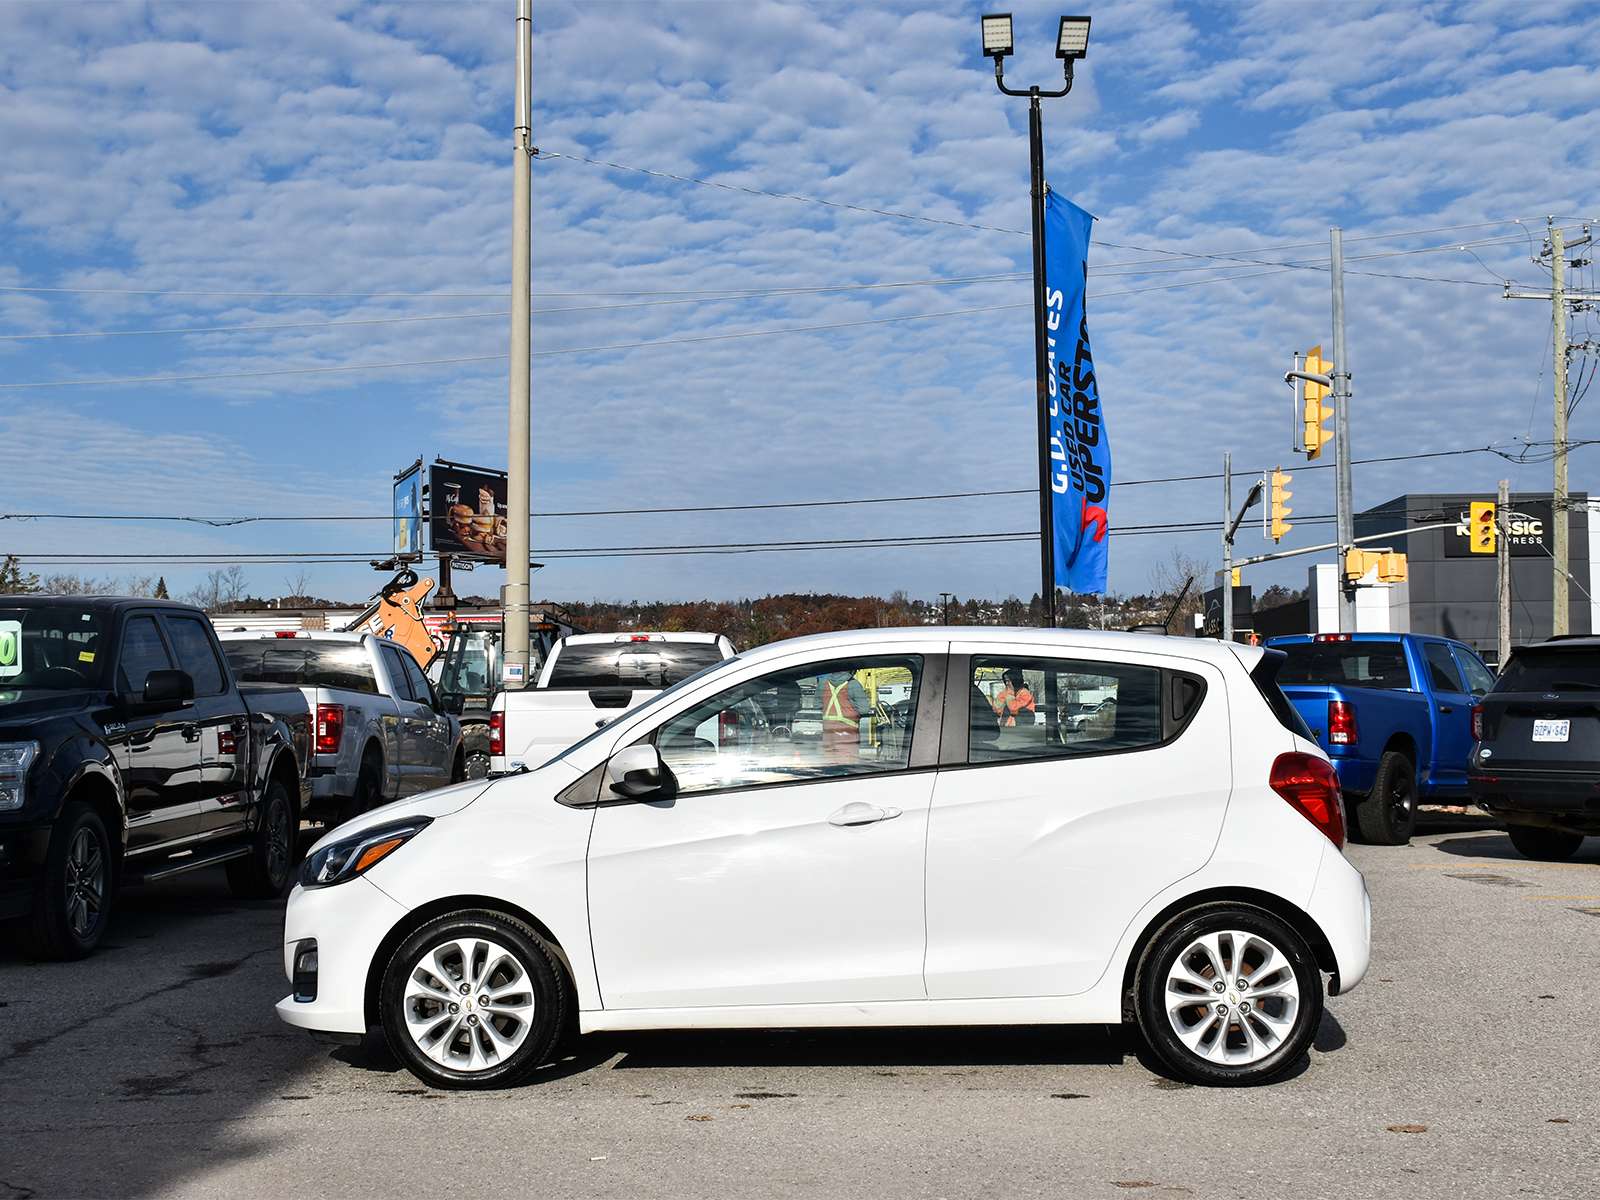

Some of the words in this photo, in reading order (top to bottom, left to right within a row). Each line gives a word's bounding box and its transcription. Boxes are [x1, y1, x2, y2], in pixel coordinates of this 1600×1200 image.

[1059, 361, 1073, 416] CAR
[1063, 420, 1085, 492] USED
[1456, 521, 1543, 536] KSIC
